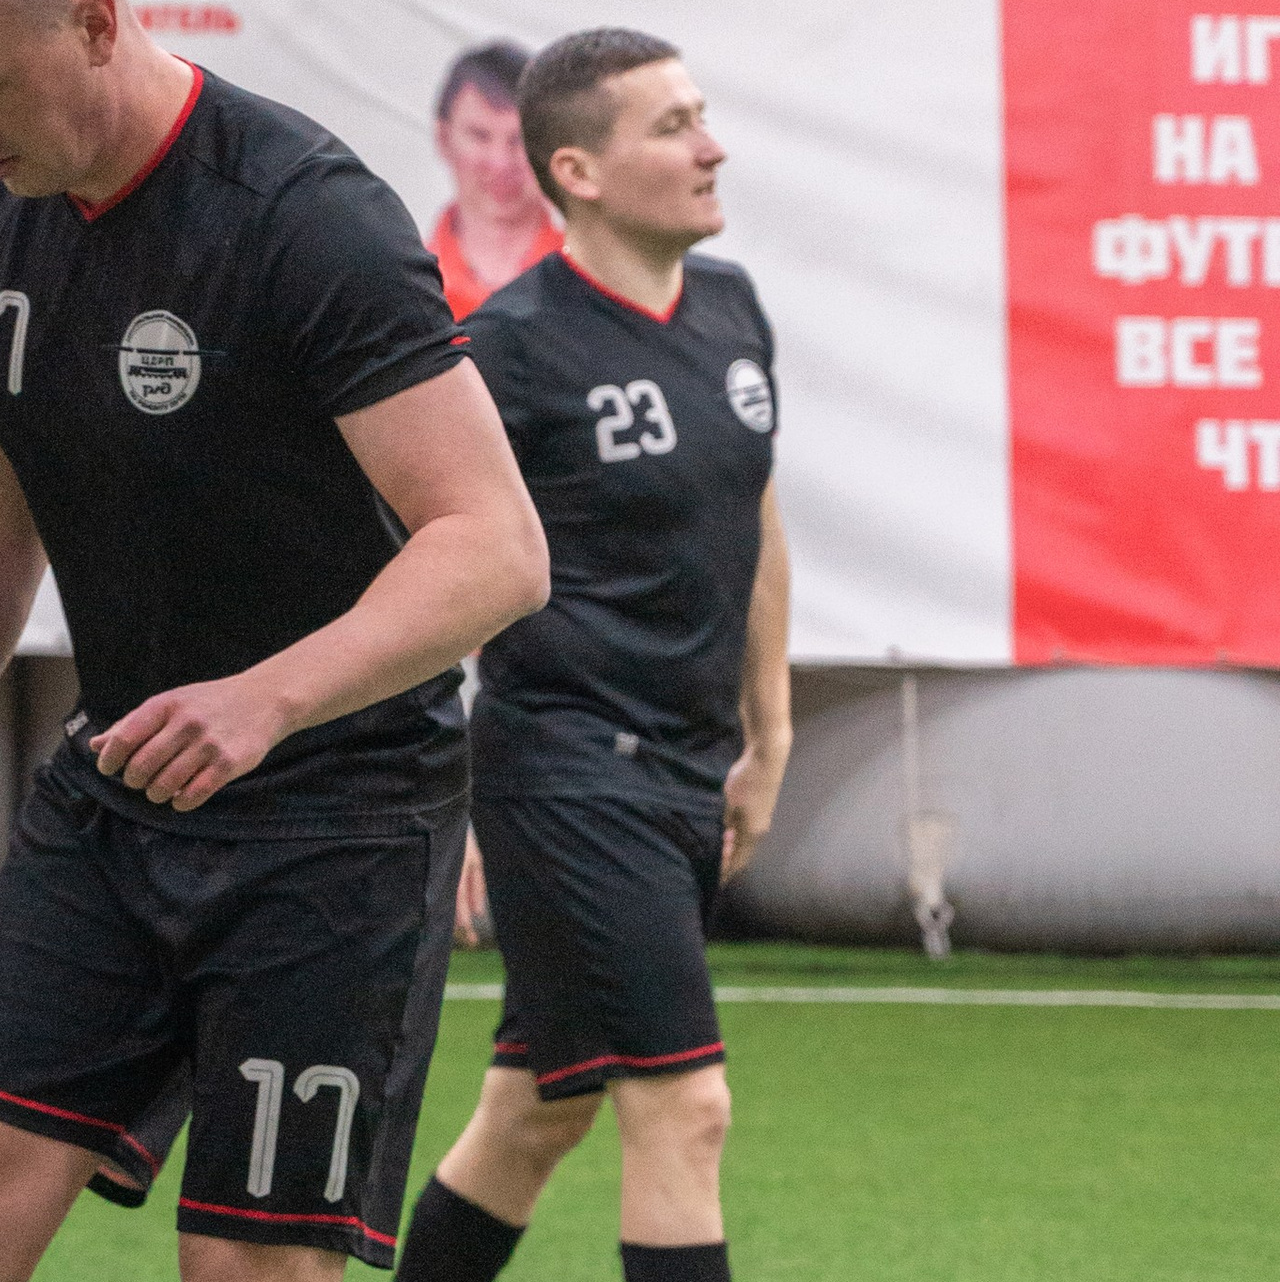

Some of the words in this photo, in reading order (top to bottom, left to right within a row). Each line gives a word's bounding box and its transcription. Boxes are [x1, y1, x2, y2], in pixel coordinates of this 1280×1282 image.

[1153, 113, 1261, 185] НА
[1115, 316, 1264, 389] ВСЕ
[586, 378, 677, 464] 23
[238, 1057, 361, 1204] 17
